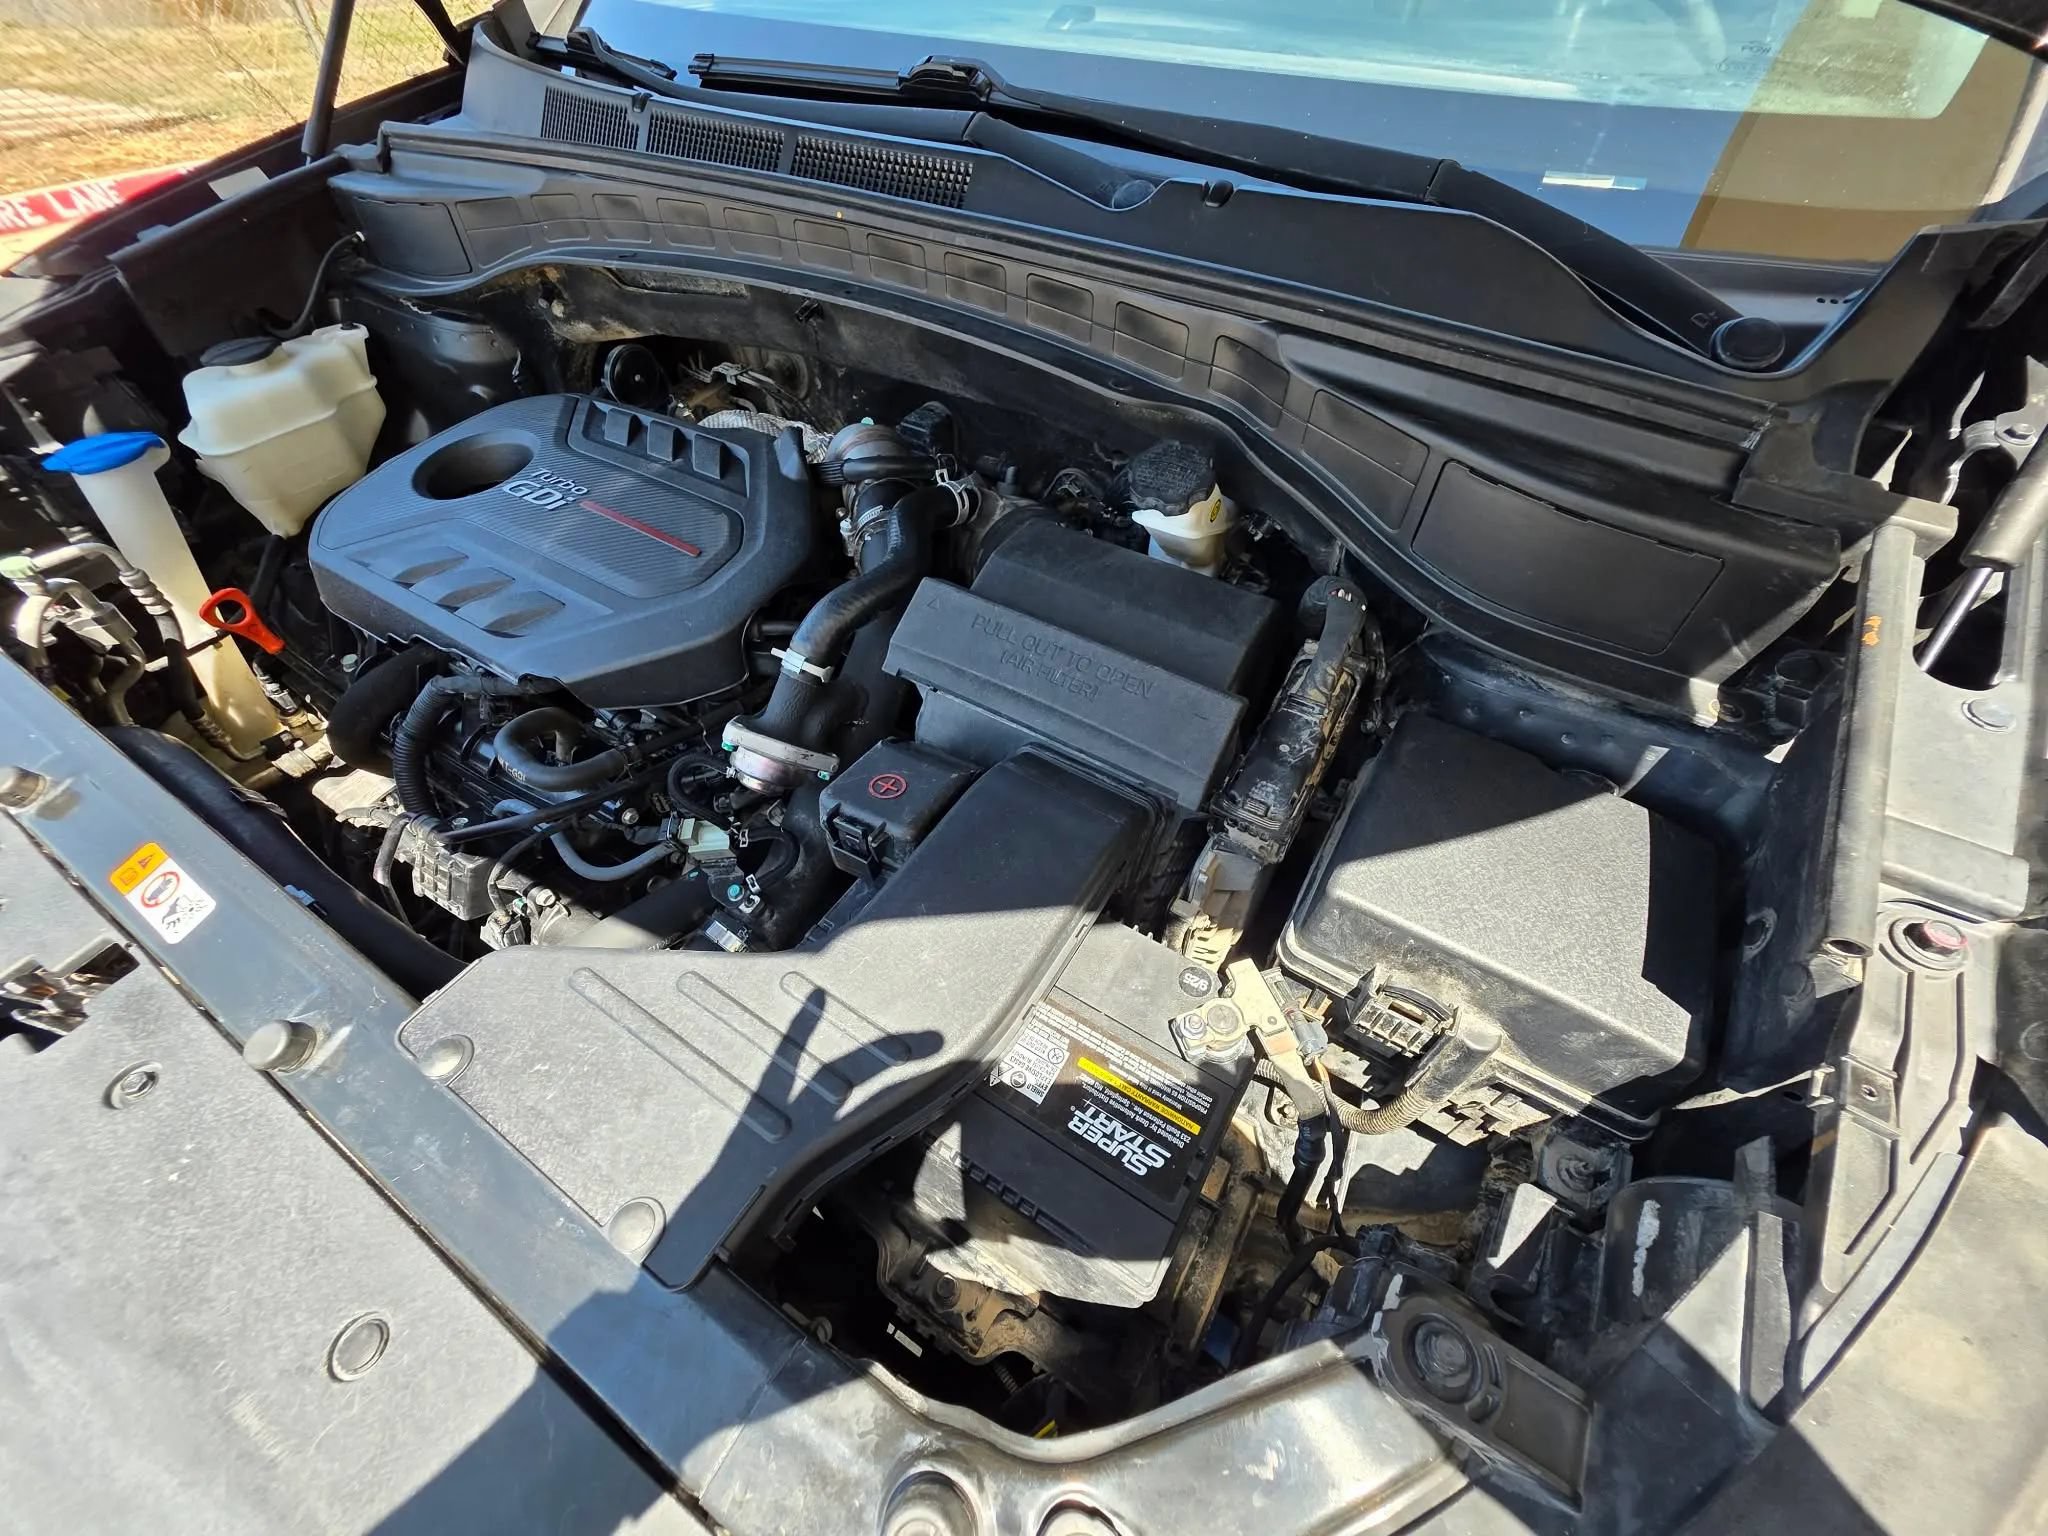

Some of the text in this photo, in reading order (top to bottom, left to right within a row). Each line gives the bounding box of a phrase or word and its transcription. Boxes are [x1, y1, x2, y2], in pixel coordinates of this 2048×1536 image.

[45, 179, 124, 218] LANE
[531, 468, 589, 495] Turbo
[502, 480, 576, 511] GDi
[970, 613, 1156, 700] PULL OUT TO OPEN
[1024, 1064, 1052, 1084] EXPLOSIVE
[1026, 1082, 1045, 1097] SHIELD
[1107, 1098, 1135, 1118] Automotive
[1117, 1082, 1193, 1130] NATIONWIDE WARRANTY CALL
[1176, 1092, 1208, 1115] PROPOSITION
[1134, 1114, 1150, 1127] Ozark
[1141, 1110, 1166, 1128] Patterson
[1164, 1123, 1181, 1137] South
[1067, 1115, 1149, 1176] SUPER
[1073, 1104, 1172, 1169] START
[1156, 1127, 1185, 1148] Distributed
[1179, 1132, 1191, 1143] 233
